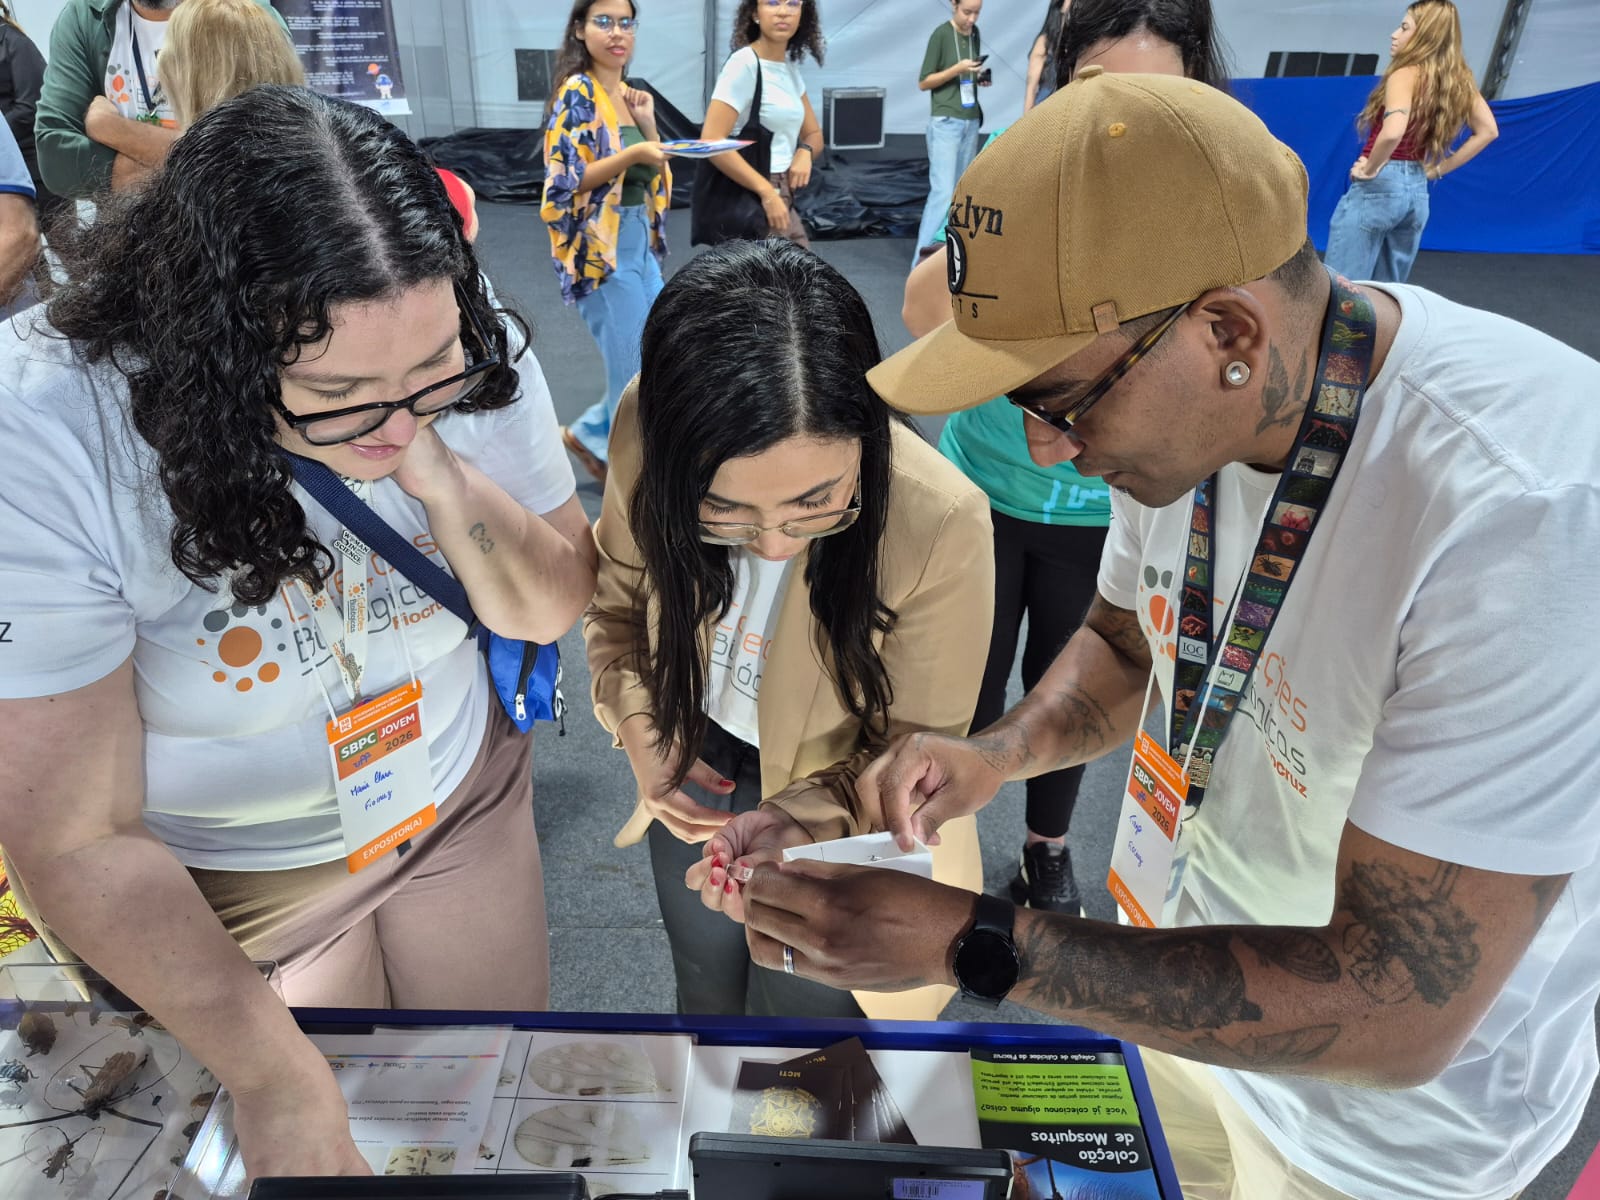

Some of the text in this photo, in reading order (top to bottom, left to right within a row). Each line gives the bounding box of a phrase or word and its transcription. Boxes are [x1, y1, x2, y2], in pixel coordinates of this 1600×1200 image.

[947, 195, 1003, 239] klyn
[1183, 642, 1205, 657] IOC
[341, 732, 377, 759] SBPC
[381, 713, 415, 738] JOVEM
[385, 730, 414, 752] 2026
[1134, 765, 1155, 793] SBPC
[1154, 787, 1177, 817] JOVEM
[1151, 806, 1170, 832] 2026
[362, 816, 423, 860] EXPOSITOR(A)
[1070, 1053, 1096, 1062] Coleção
[779, 1070, 801, 1079] MCTI
[980, 1103, 1128, 1115] Você já colecionou alguma coisa?
[1030, 1129, 1135, 1147] de Mosquitos
[1078, 1148, 1140, 1165] Coleção
